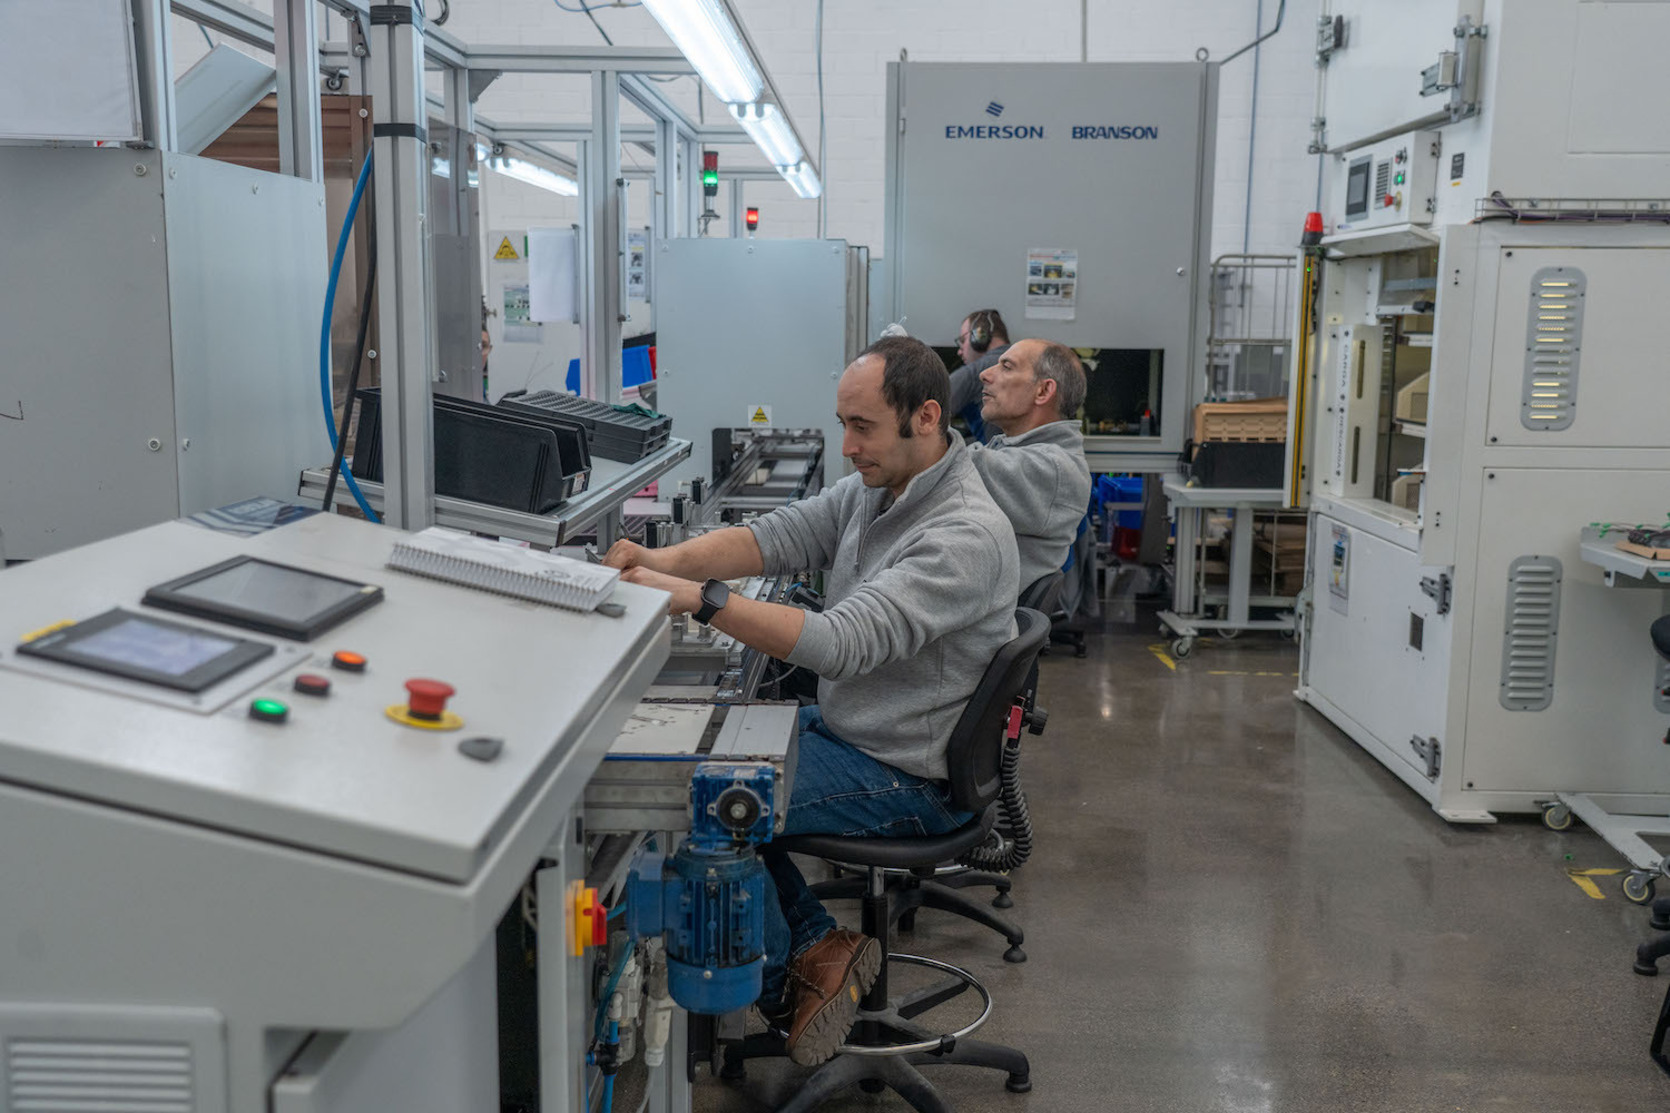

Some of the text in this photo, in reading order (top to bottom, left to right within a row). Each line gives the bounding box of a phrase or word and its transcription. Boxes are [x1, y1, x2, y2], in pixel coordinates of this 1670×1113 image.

[945, 126, 1044, 139] EMERSON
[1072, 126, 1158, 139] BRANSON
[1341, 344, 1349, 388] CARGA
